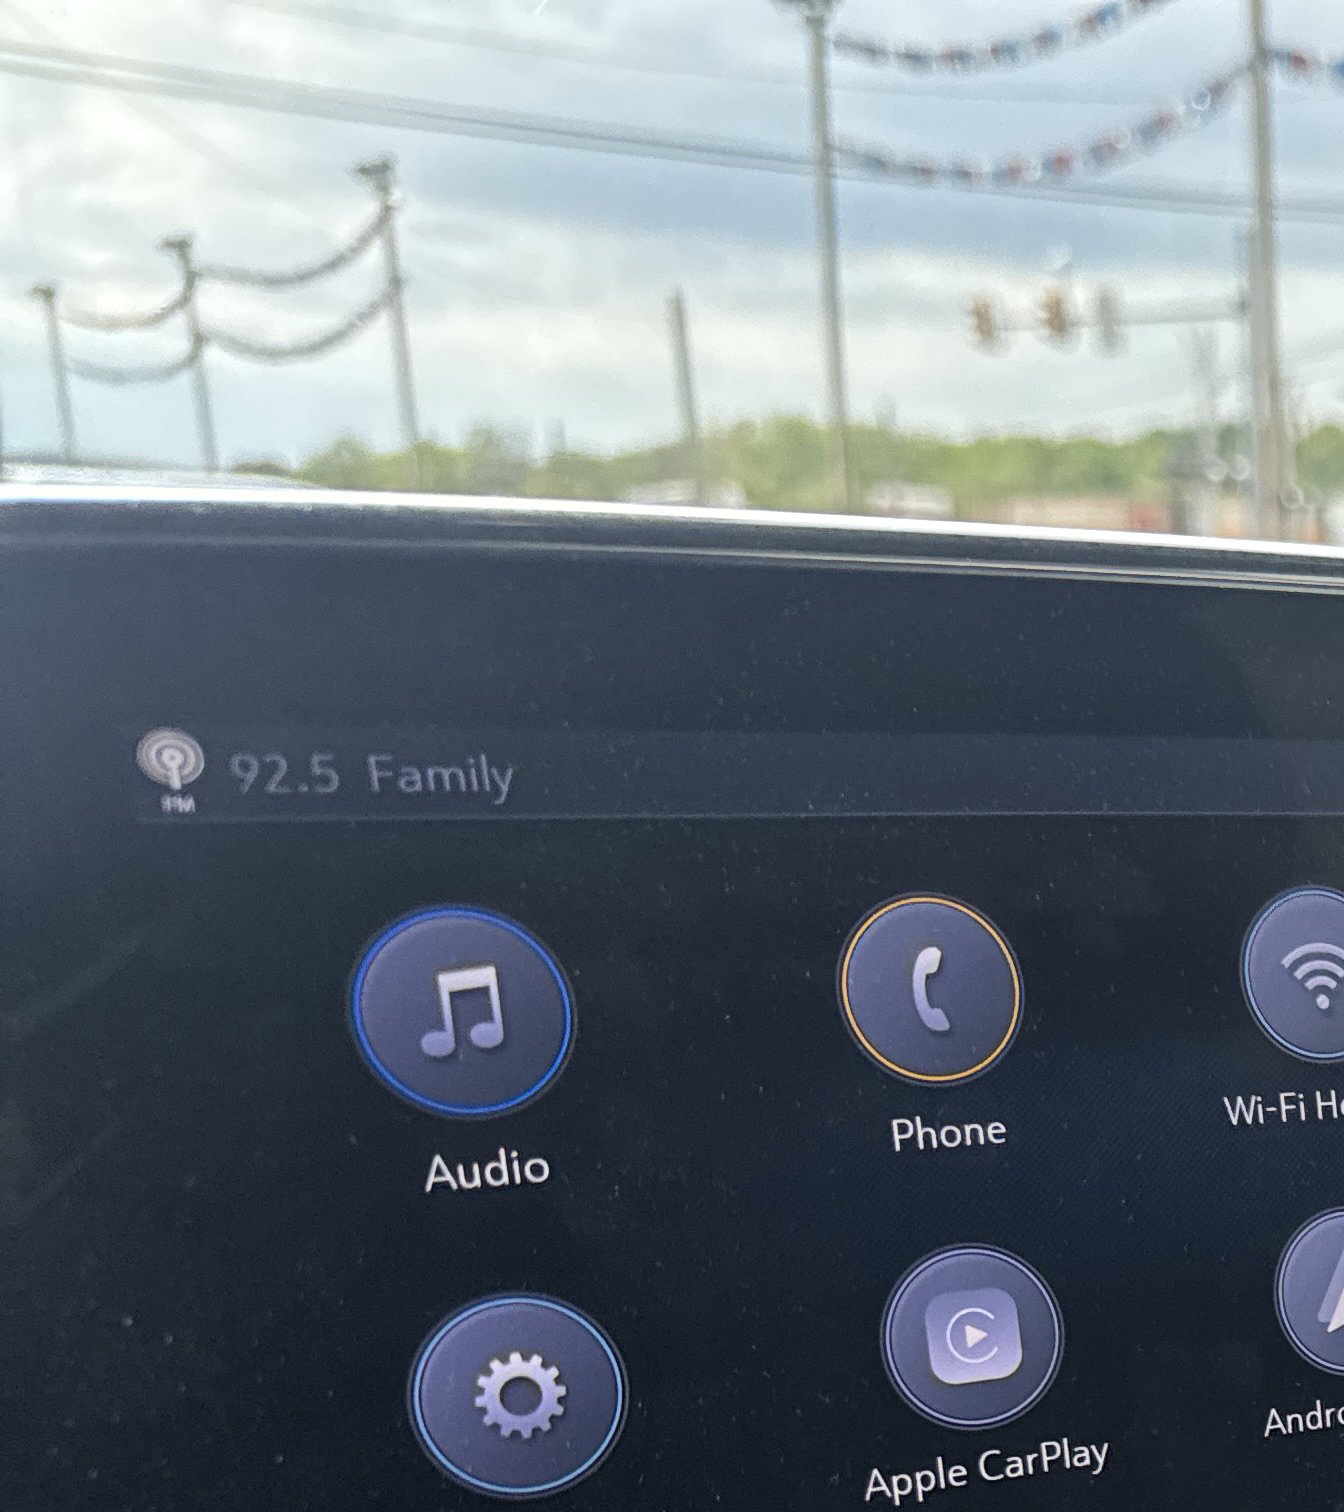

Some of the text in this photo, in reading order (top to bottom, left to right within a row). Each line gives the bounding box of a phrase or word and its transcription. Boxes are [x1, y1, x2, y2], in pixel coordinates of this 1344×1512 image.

[229, 752, 514, 805] 92.5 Family
[1223, 1091, 1306, 1126] Wi-Fi
[891, 1114, 1007, 1152] Phone
[424, 1146, 550, 1193] Audio
[864, 1437, 1109, 1507] Apple CarPlay
